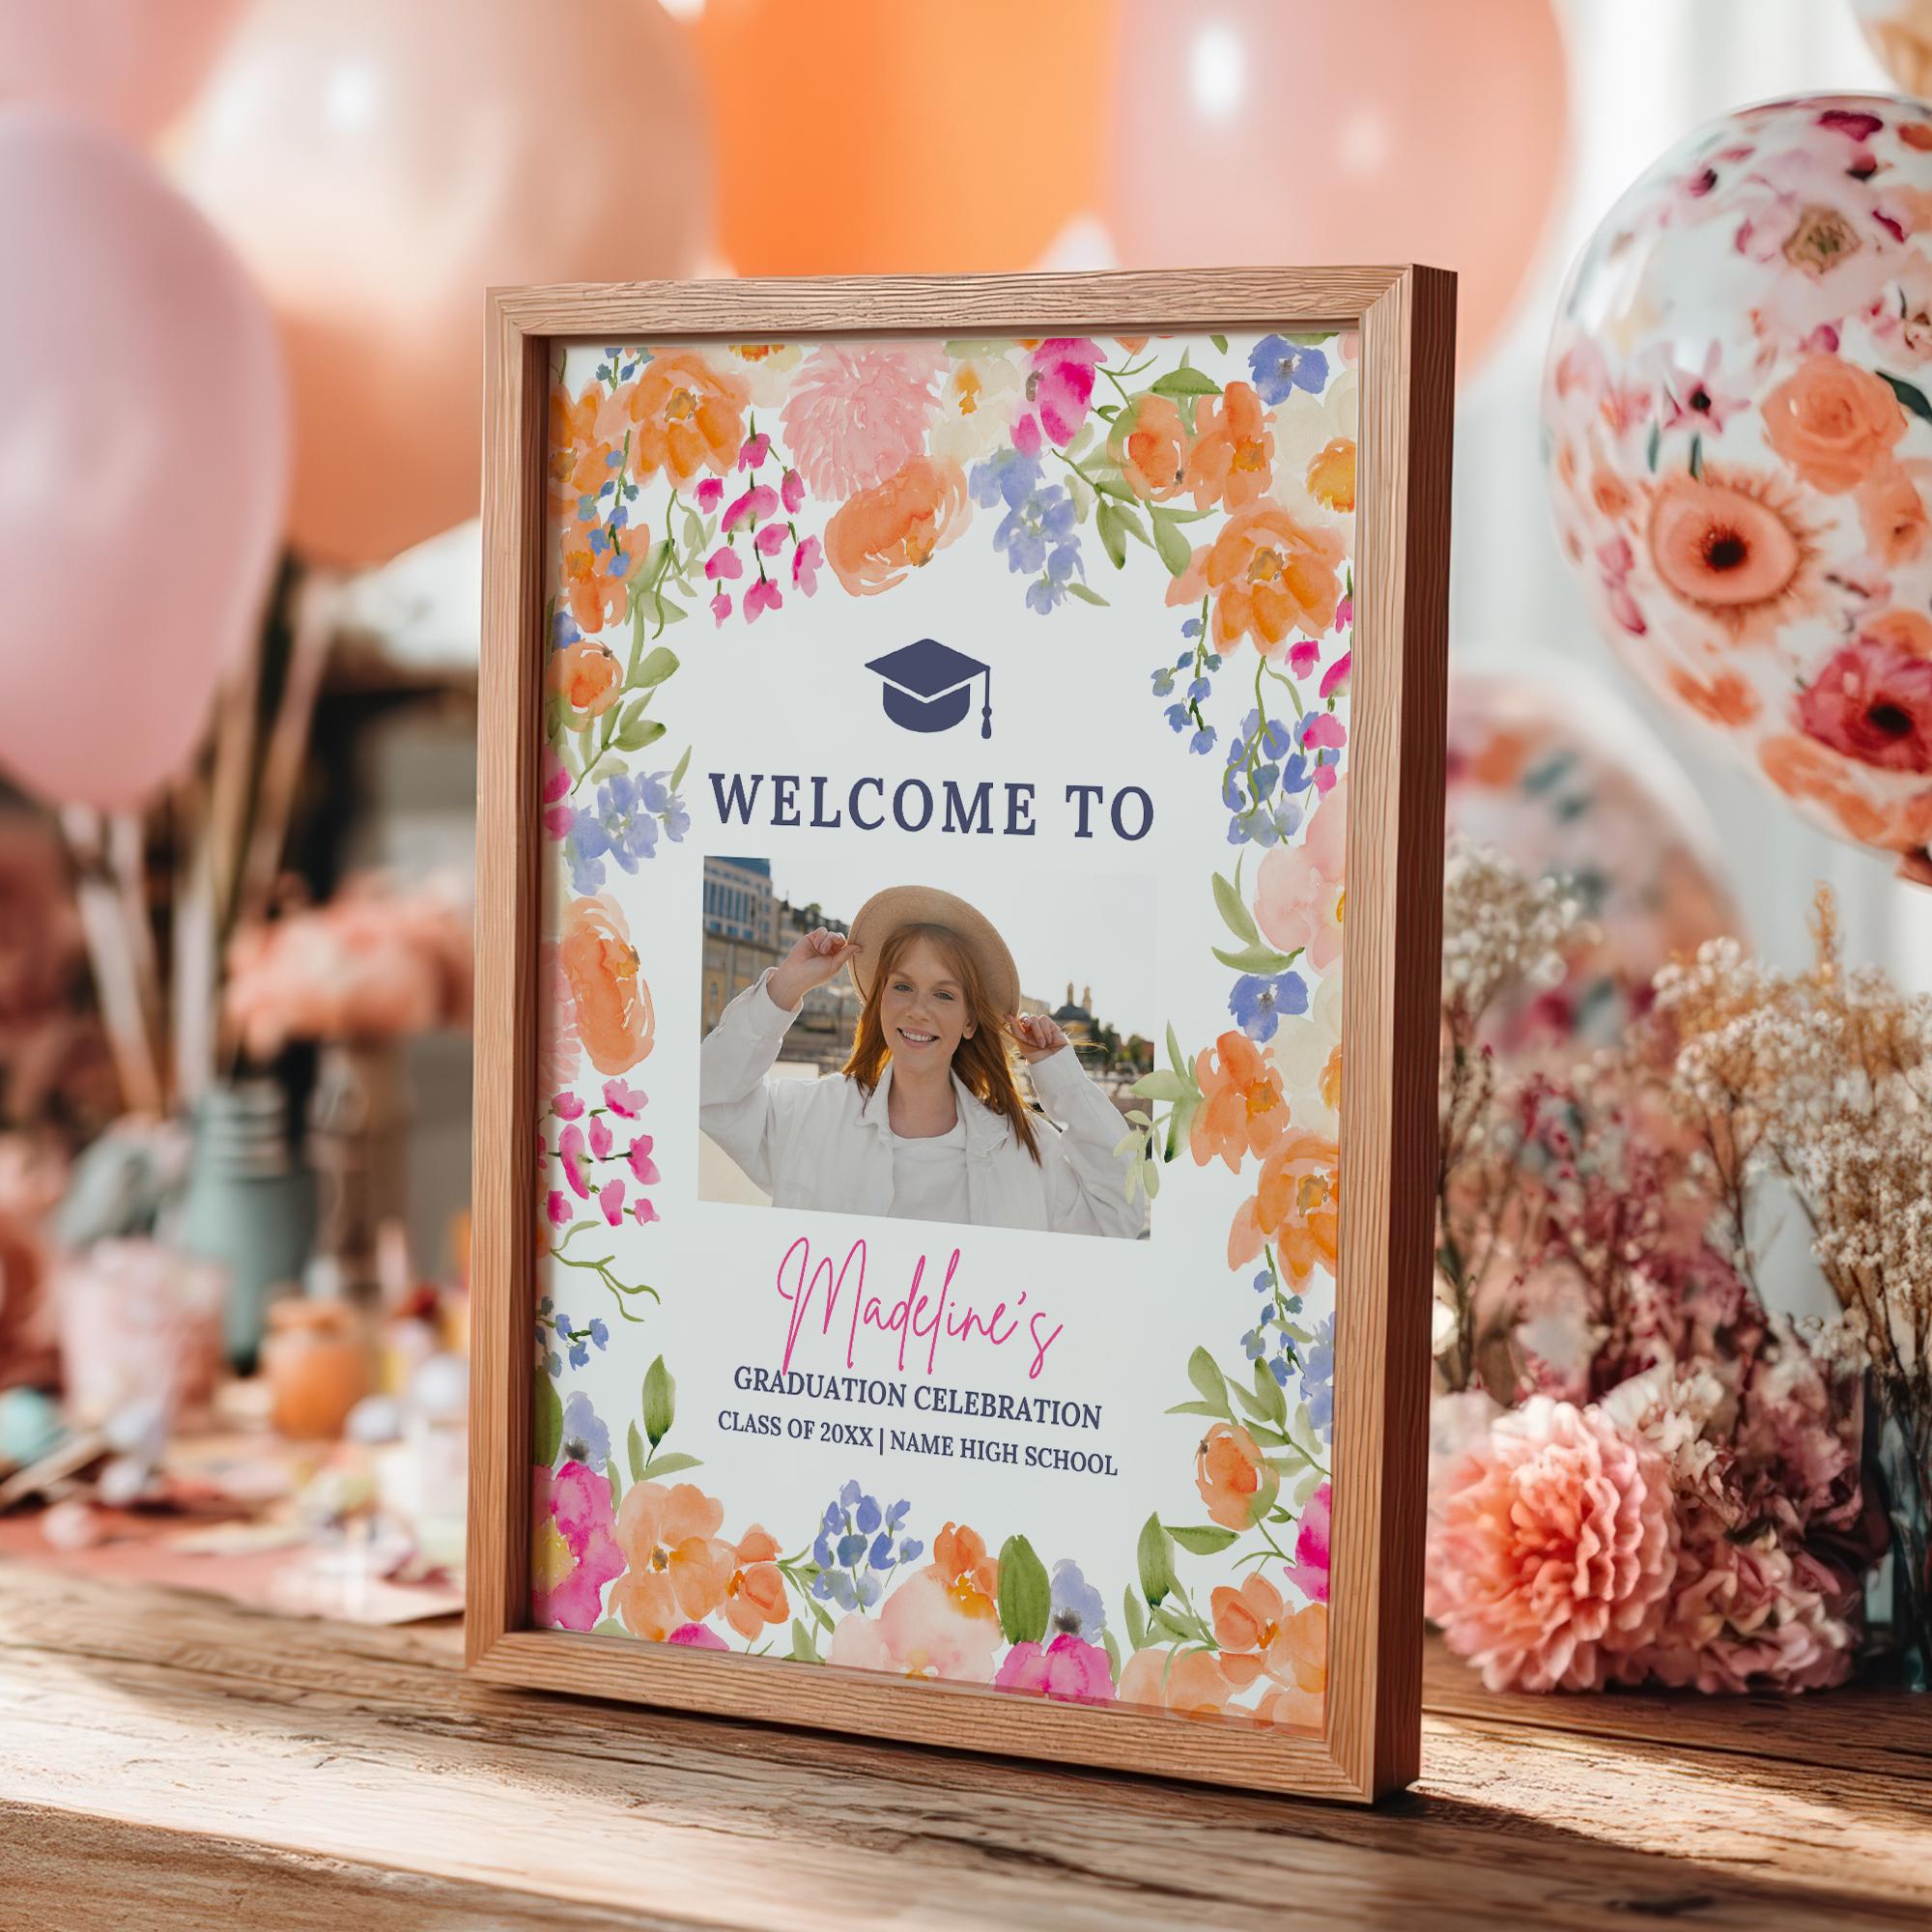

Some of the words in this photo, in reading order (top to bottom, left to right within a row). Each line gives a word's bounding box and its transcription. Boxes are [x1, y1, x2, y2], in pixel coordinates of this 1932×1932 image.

[708, 773, 1037, 836] WELCOME
[1065, 784, 1154, 841] TO
[734, 1365, 906, 1408] GRADUATION
[914, 1385, 1102, 1430] CELEBRATION
[718, 1410, 781, 1436] CLASS
[787, 1418, 815, 1439] OF
[820, 1422, 873, 1447] 20XX
[890, 1430, 953, 1457] NAME
[959, 1438, 1019, 1464] HIGH
[1024, 1446, 1119, 1476] SCHOOL
